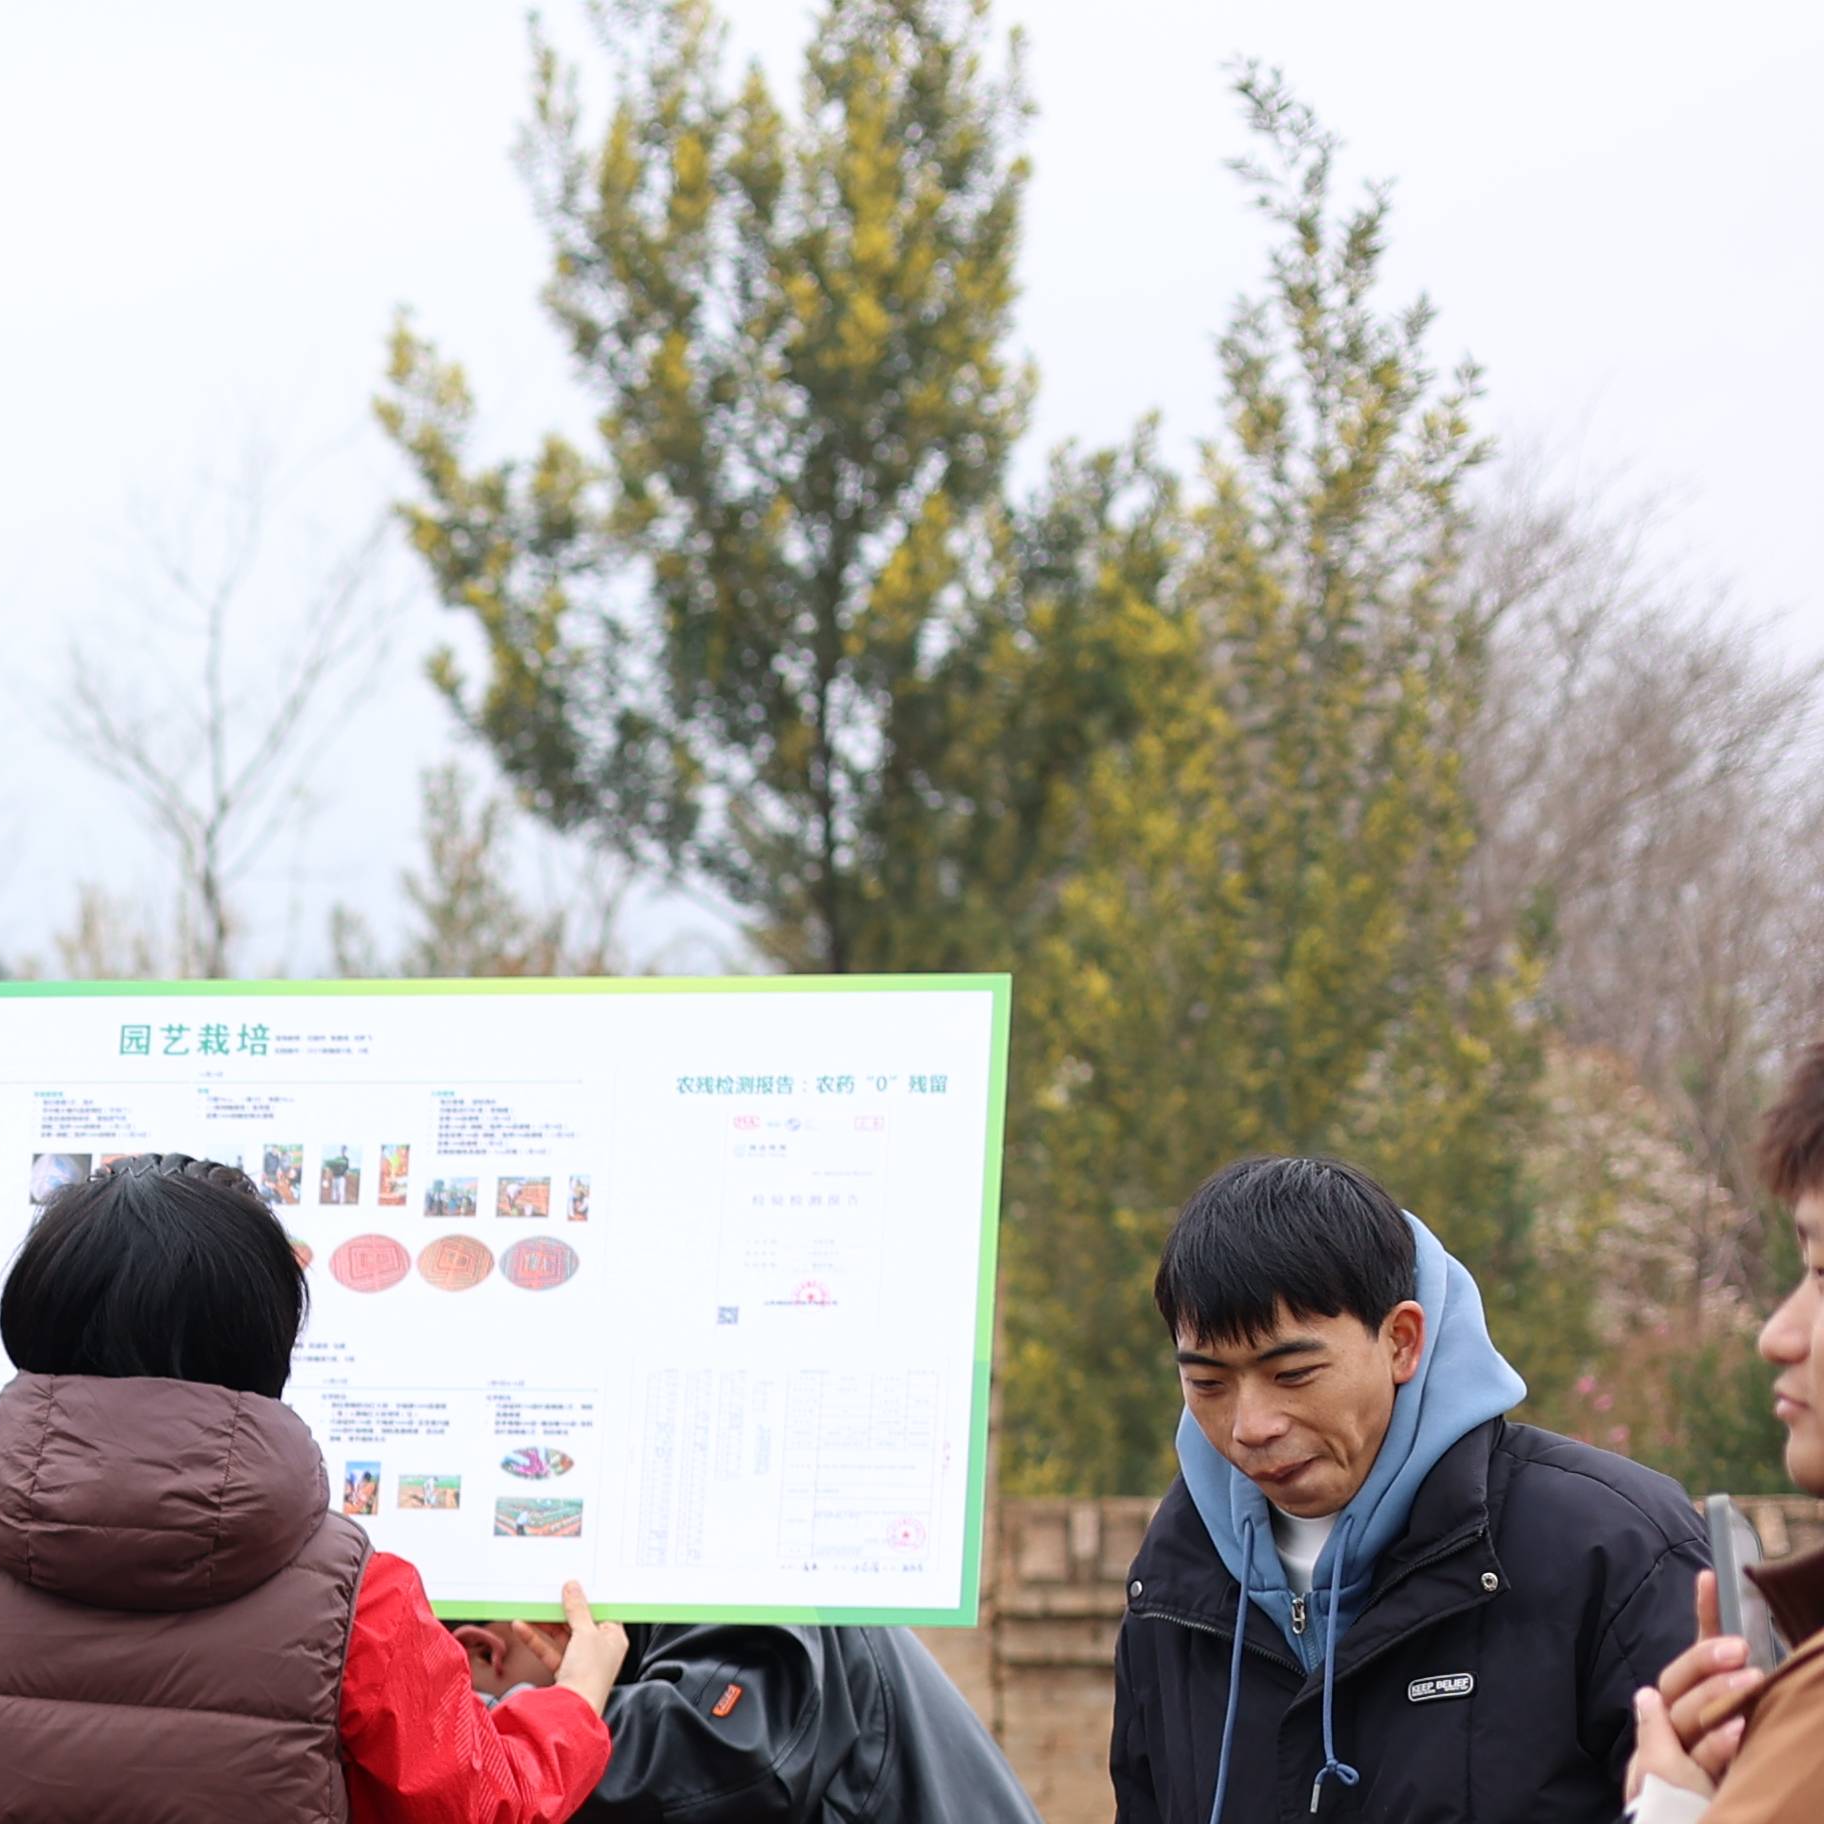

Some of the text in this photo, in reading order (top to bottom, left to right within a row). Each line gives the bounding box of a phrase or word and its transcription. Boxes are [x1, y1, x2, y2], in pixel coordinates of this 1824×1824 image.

[119, 1023, 270, 1057] 园艺栽培
[1412, 1678, 1469, 1692] KEEP BELIEF
